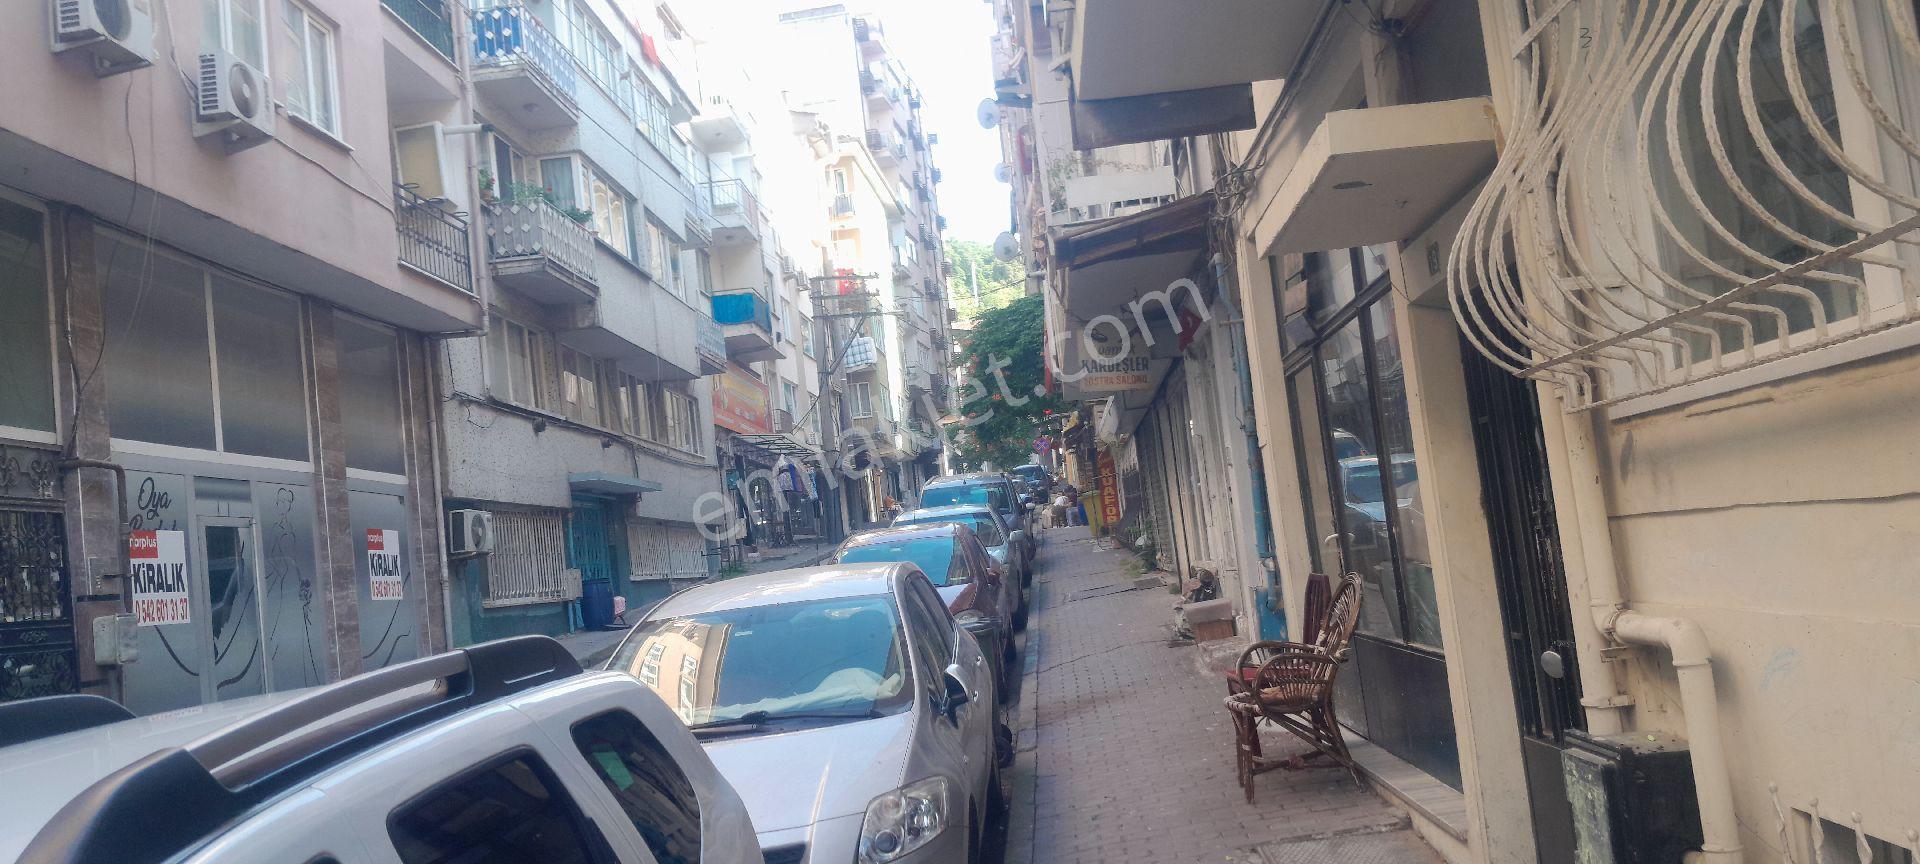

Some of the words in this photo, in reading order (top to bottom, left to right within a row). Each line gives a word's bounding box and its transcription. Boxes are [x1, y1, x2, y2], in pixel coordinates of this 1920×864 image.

[1082, 356, 1149, 374] KARDEŞLER
[138, 476, 172, 520] Oya
[135, 600, 141, 624] 0
[141, 599, 156, 624] 542
[156, 599, 169, 623] 601
[170, 598, 179, 621] 31
[179, 597, 189, 621] 37
